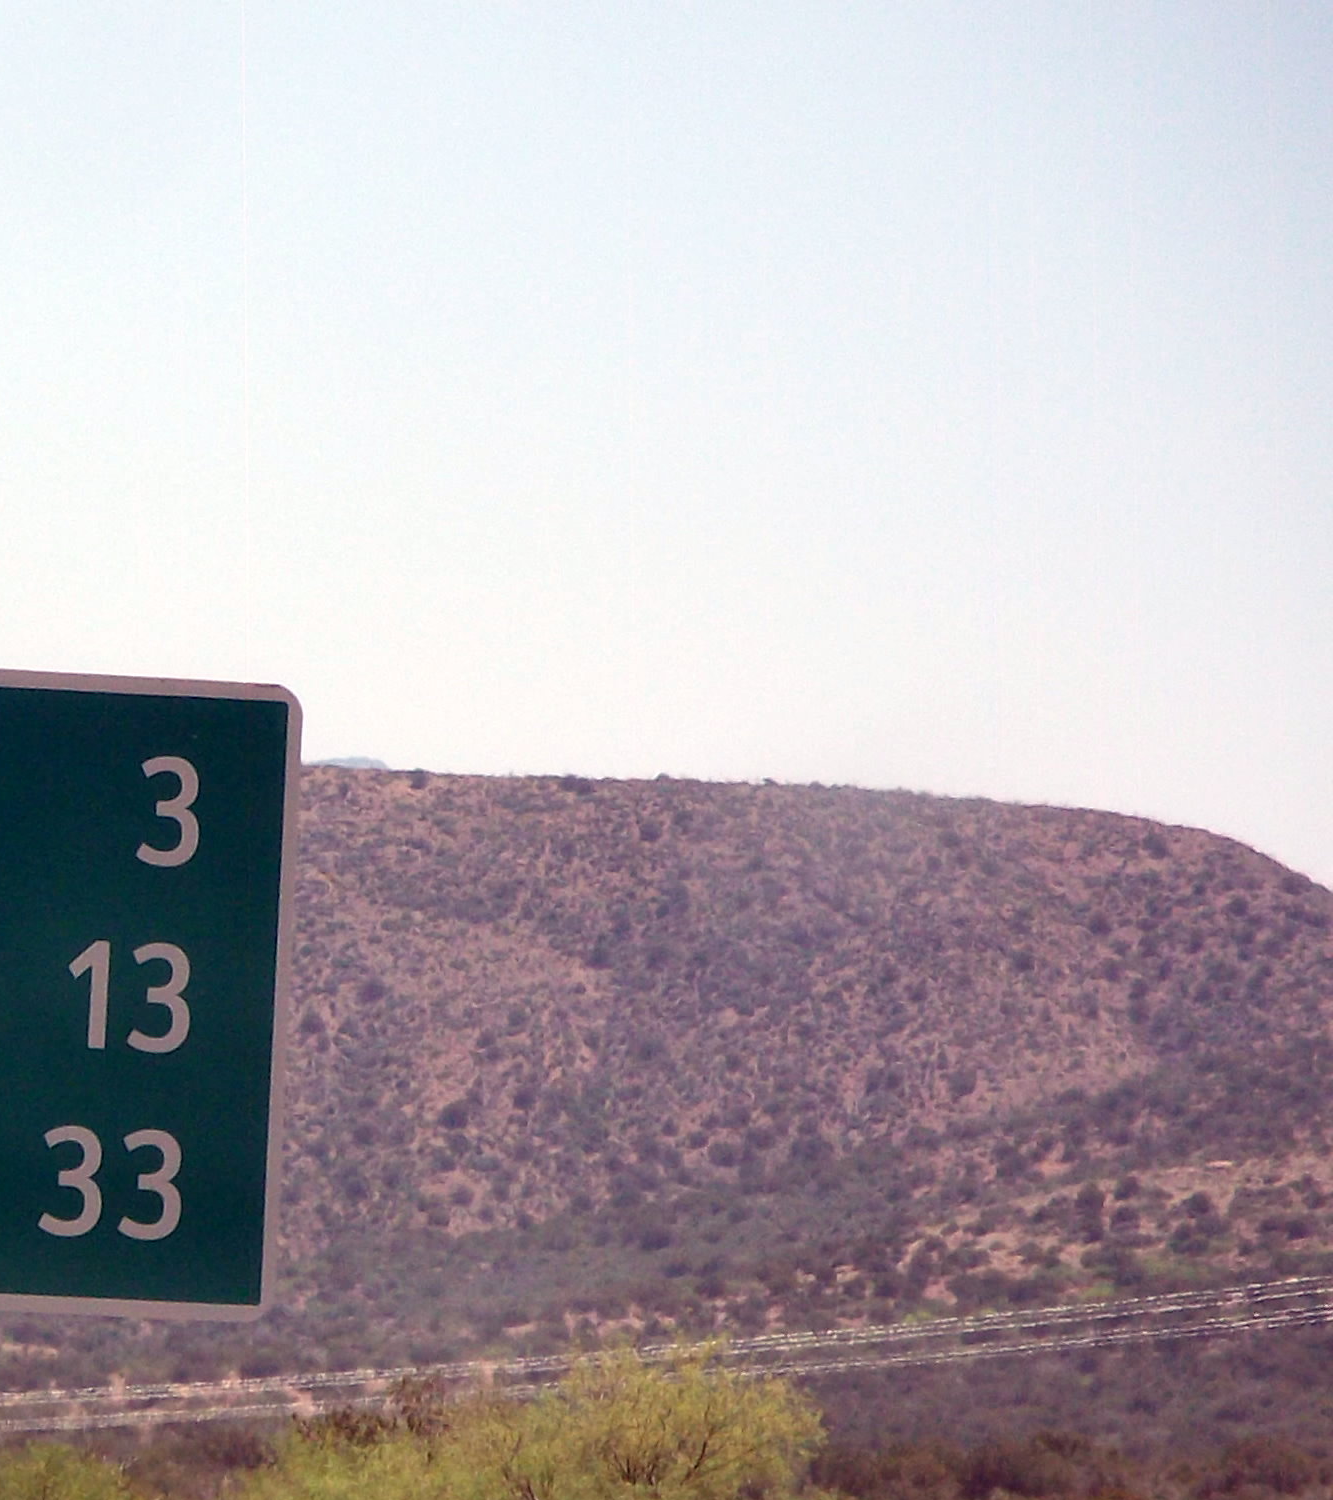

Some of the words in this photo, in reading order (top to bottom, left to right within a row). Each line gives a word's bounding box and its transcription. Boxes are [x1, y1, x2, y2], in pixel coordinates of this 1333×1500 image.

[136, 756, 199, 867] 3
[69, 940, 190, 1053] 13
[38, 1125, 182, 1240] 33
